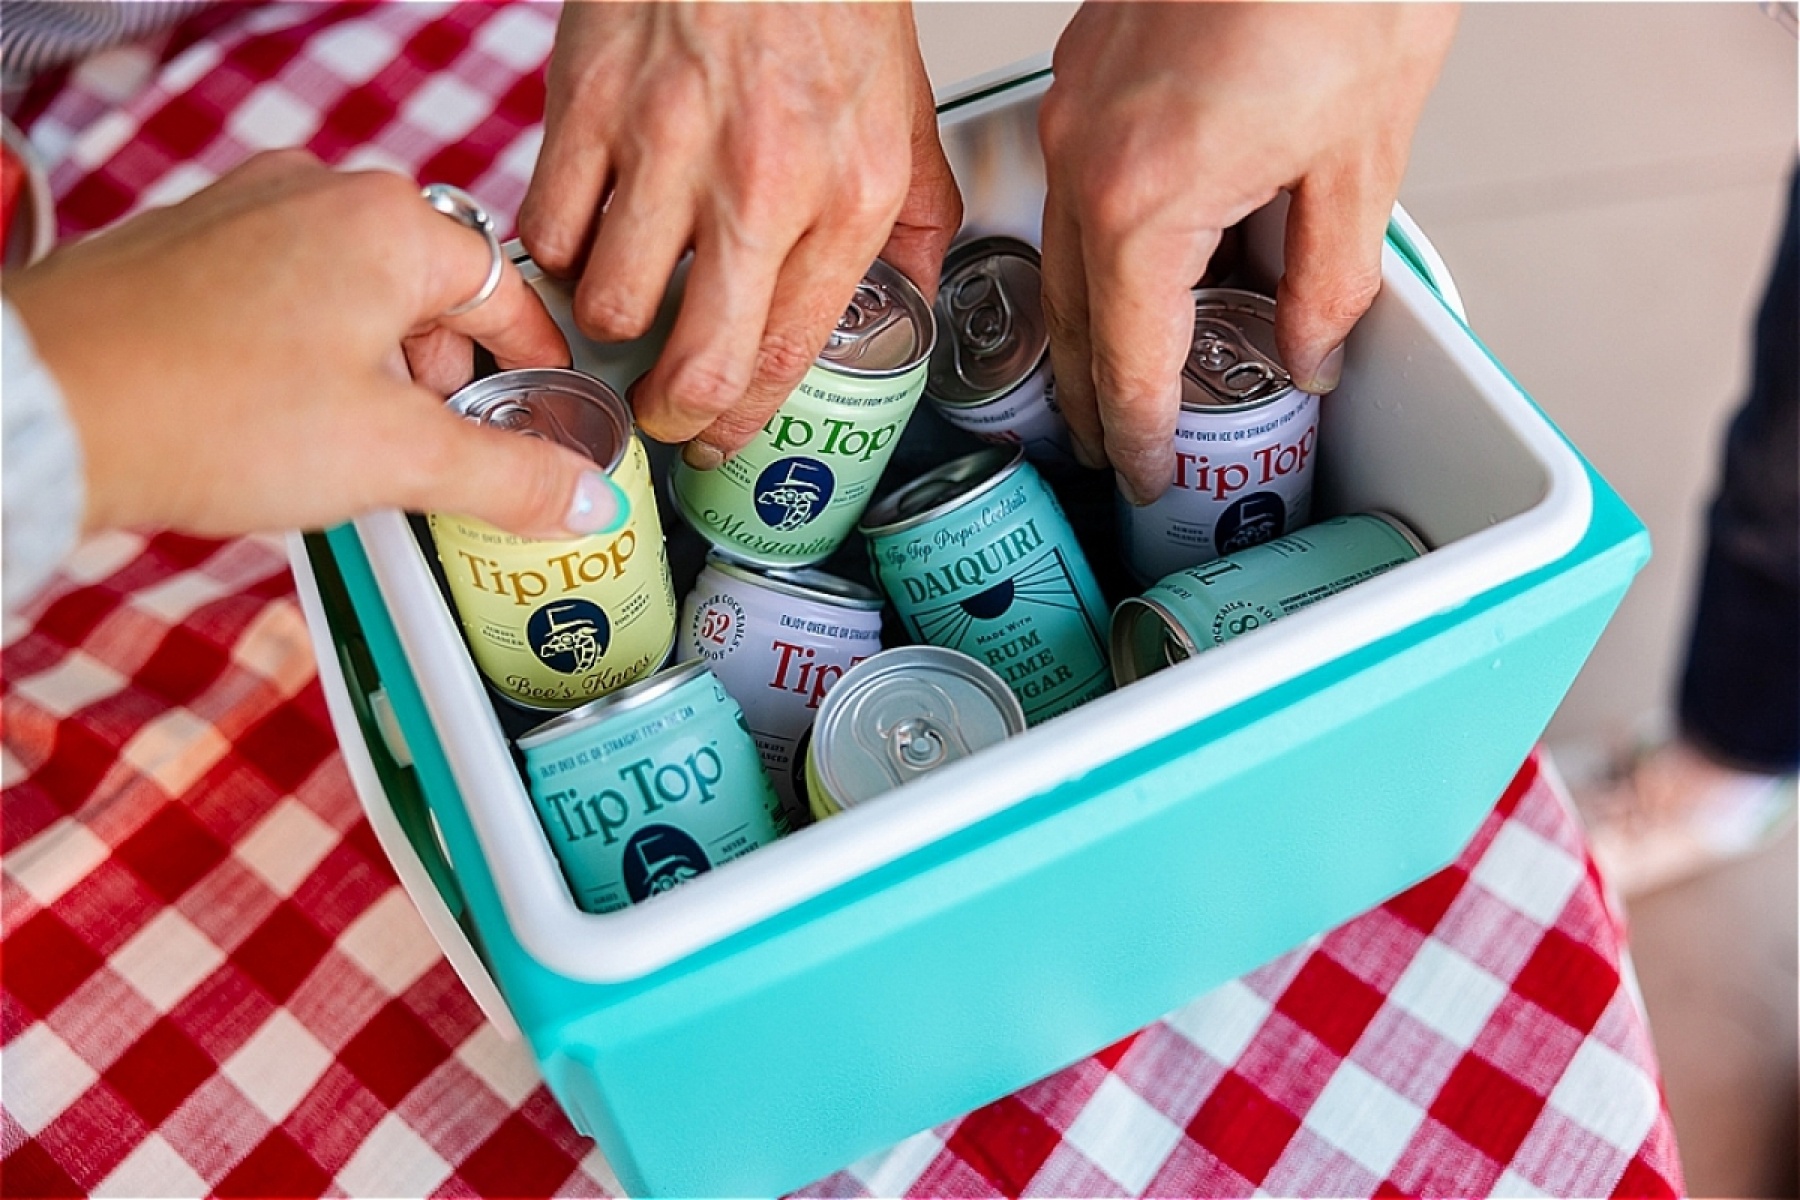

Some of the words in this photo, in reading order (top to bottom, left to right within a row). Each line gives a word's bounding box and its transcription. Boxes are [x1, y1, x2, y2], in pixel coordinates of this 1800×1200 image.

[817, 417, 897, 462] Top
[1175, 428, 1195, 439] NJOY
[1197, 431, 1217, 442] OVER
[1219, 431, 1232, 442] ICE
[1234, 430, 1245, 440] OR
[1247, 419, 1279, 439] STRAIGHT
[1173, 451, 1249, 502] Tip
[1253, 425, 1316, 485] Top
[458, 550, 548, 606] Tip
[547, 528, 636, 593] Top
[902, 518, 1045, 605] DAIQUIRI
[701, 608, 730, 645] 52
[722, 593, 746, 648] COCKTAILS
[780, 614, 806, 629] ENJOY
[806, 620, 826, 635] OVER
[1212, 600, 1246, 643] OCKTAILS
[984, 628, 1042, 667] RUM
[1003, 647, 1055, 685] IME
[506, 674, 576, 699] Bee's
[581, 654, 651, 695] Knees
[768, 639, 844, 709] Tip
[546, 788, 628, 846] Tip
[618, 744, 723, 816] Top
